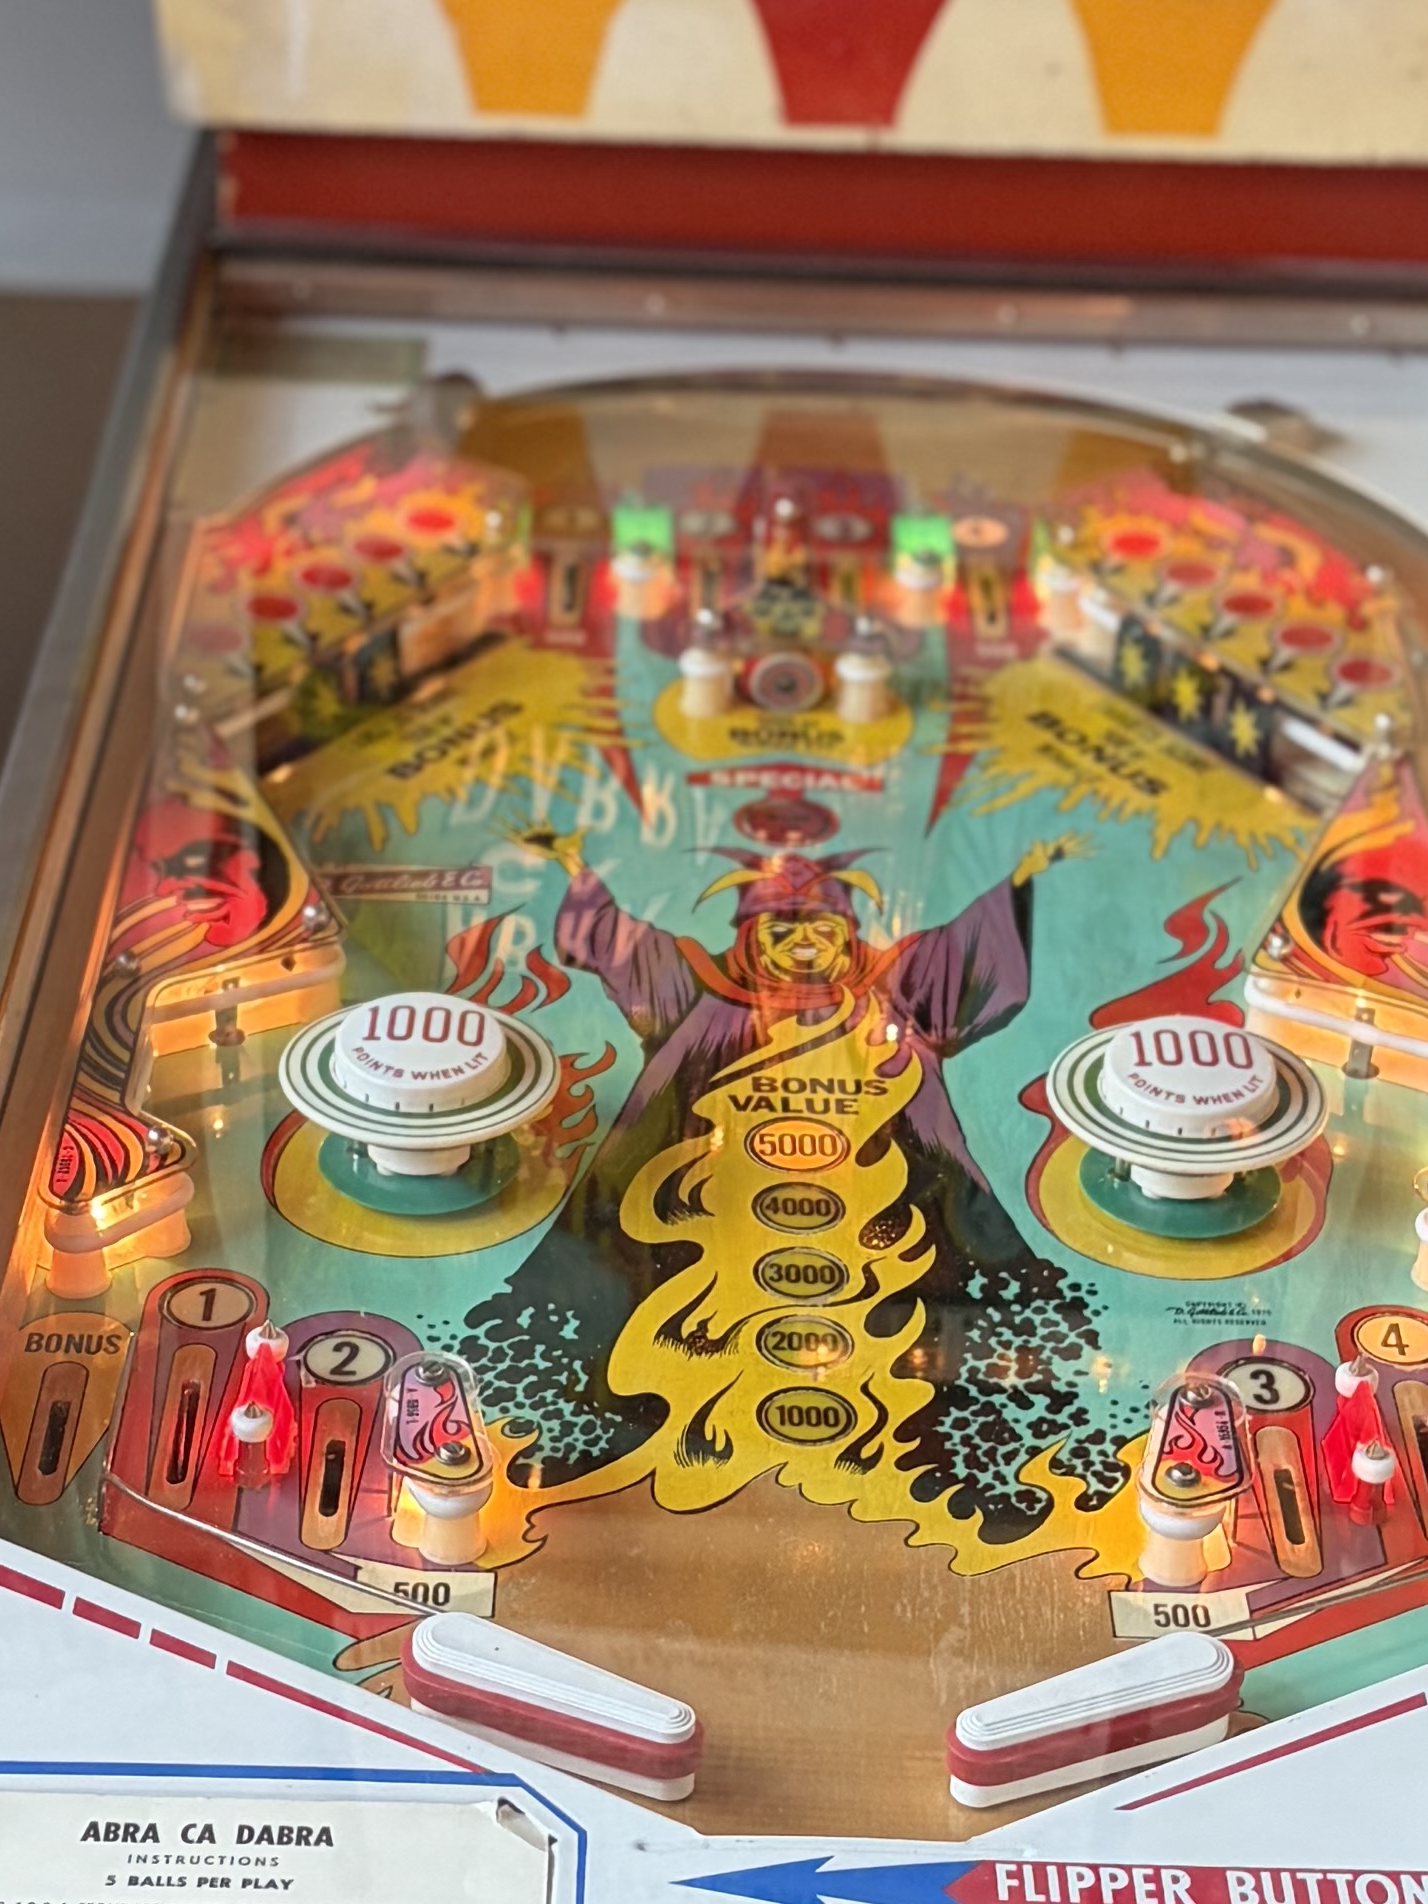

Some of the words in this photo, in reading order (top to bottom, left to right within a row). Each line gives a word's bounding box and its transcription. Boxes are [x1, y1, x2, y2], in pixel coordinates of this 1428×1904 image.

[362, 1005, 485, 1047] 1000
[1130, 1029, 1253, 1069] 1000
[352, 1046, 405, 1079] POINTS
[411, 1065, 465, 1081] WHEN
[464, 1052, 488, 1070] LIT
[751, 1076, 889, 1096] BONUS
[1128, 1073, 1185, 1104] POINTS
[1192, 1089, 1245, 1105] WHEN
[1243, 1075, 1264, 1093] LIT
[728, 1095, 860, 1116] VALUE
[757, 1132, 838, 1157] 5000
[765, 1196, 832, 1217] 4000
[768, 1263, 837, 1284] 3000
[199, 1288, 215, 1321] 1
[25, 1331, 122, 1356] BONUS
[772, 1331, 839, 1352] 2000
[1381, 1322, 1409, 1357] 4
[330, 1341, 361, 1378] 2
[1253, 1369, 1281, 1405] 3
[775, 1404, 841, 1429] 1000
[392, 1580, 452, 1608] 500
[1152, 1601, 1213, 1630] 500
[80, 1820, 160, 1843] ABRA
[180, 1823, 217, 1844] CA
[236, 1825, 334, 1847] DABRA
[127, 1854, 280, 1867] INSTRUCTIONS
[105, 1875, 116, 1886] 5
[127, 1875, 187, 1888] BALLS
[197, 1877, 232, 1889] PER
[241, 1878, 294, 1891] PLAY
